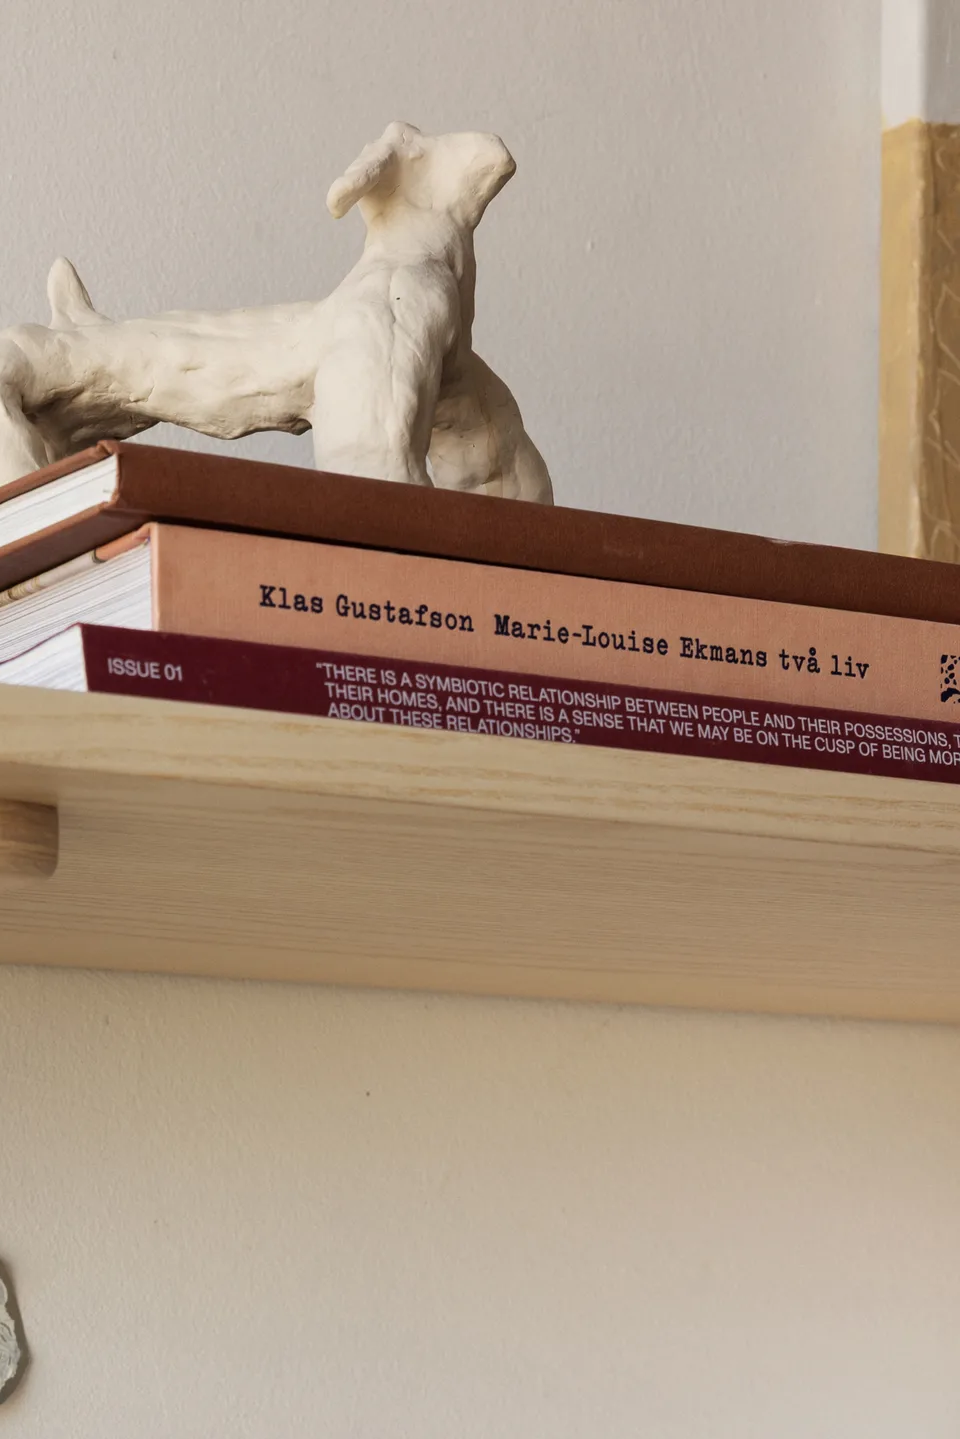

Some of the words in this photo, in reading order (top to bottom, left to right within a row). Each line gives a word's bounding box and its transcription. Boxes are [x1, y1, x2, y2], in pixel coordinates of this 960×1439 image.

[107, 657, 161, 679] ISSUE
[164, 663, 183, 681] 01
[259, 585, 323, 614] Klas
[336, 594, 474, 632] Gustafson
[494, 614, 669, 655] Marie-Louise
[680, 637, 767, 667] Ekmans
[779, 647, 820, 673] två
[830, 655, 869, 678] liv
[324, 682, 373, 702] THEIR
[377, 688, 442, 711] HOMES,
[446, 696, 480, 714] AND
[483, 700, 536, 720] THERE
[539, 706, 554, 722] IS
[558, 708, 570, 724] A
[572, 709, 624, 730] SENSE
[627, 715, 666, 734] THAT
[669, 721, 693, 738] WE
[697, 723, 730, 743] MAY
[733, 727, 753, 744] BE
[756, 730, 779, 747] ON
[781, 733, 812, 750] THE
[814, 737, 856, 754] CUSP
[858, 742, 880, 757] OF
[882, 743, 926, 762] BEING
[327, 703, 386, 723] ABOUT
[389, 708, 442, 729] THESE
[381, 669, 397, 686] IS
[400, 672, 413, 688] A
[416, 673, 505, 698] SYMBIOTIC
[508, 684, 621, 710] RELATIONSHIP
[625, 697, 699, 719] BETWEEN
[702, 706, 760, 726] PEOPLE
[763, 712, 795, 730] AND
[797, 716, 841, 735] THEIR
[844, 722, 951, 749] POSSESSIONS,
